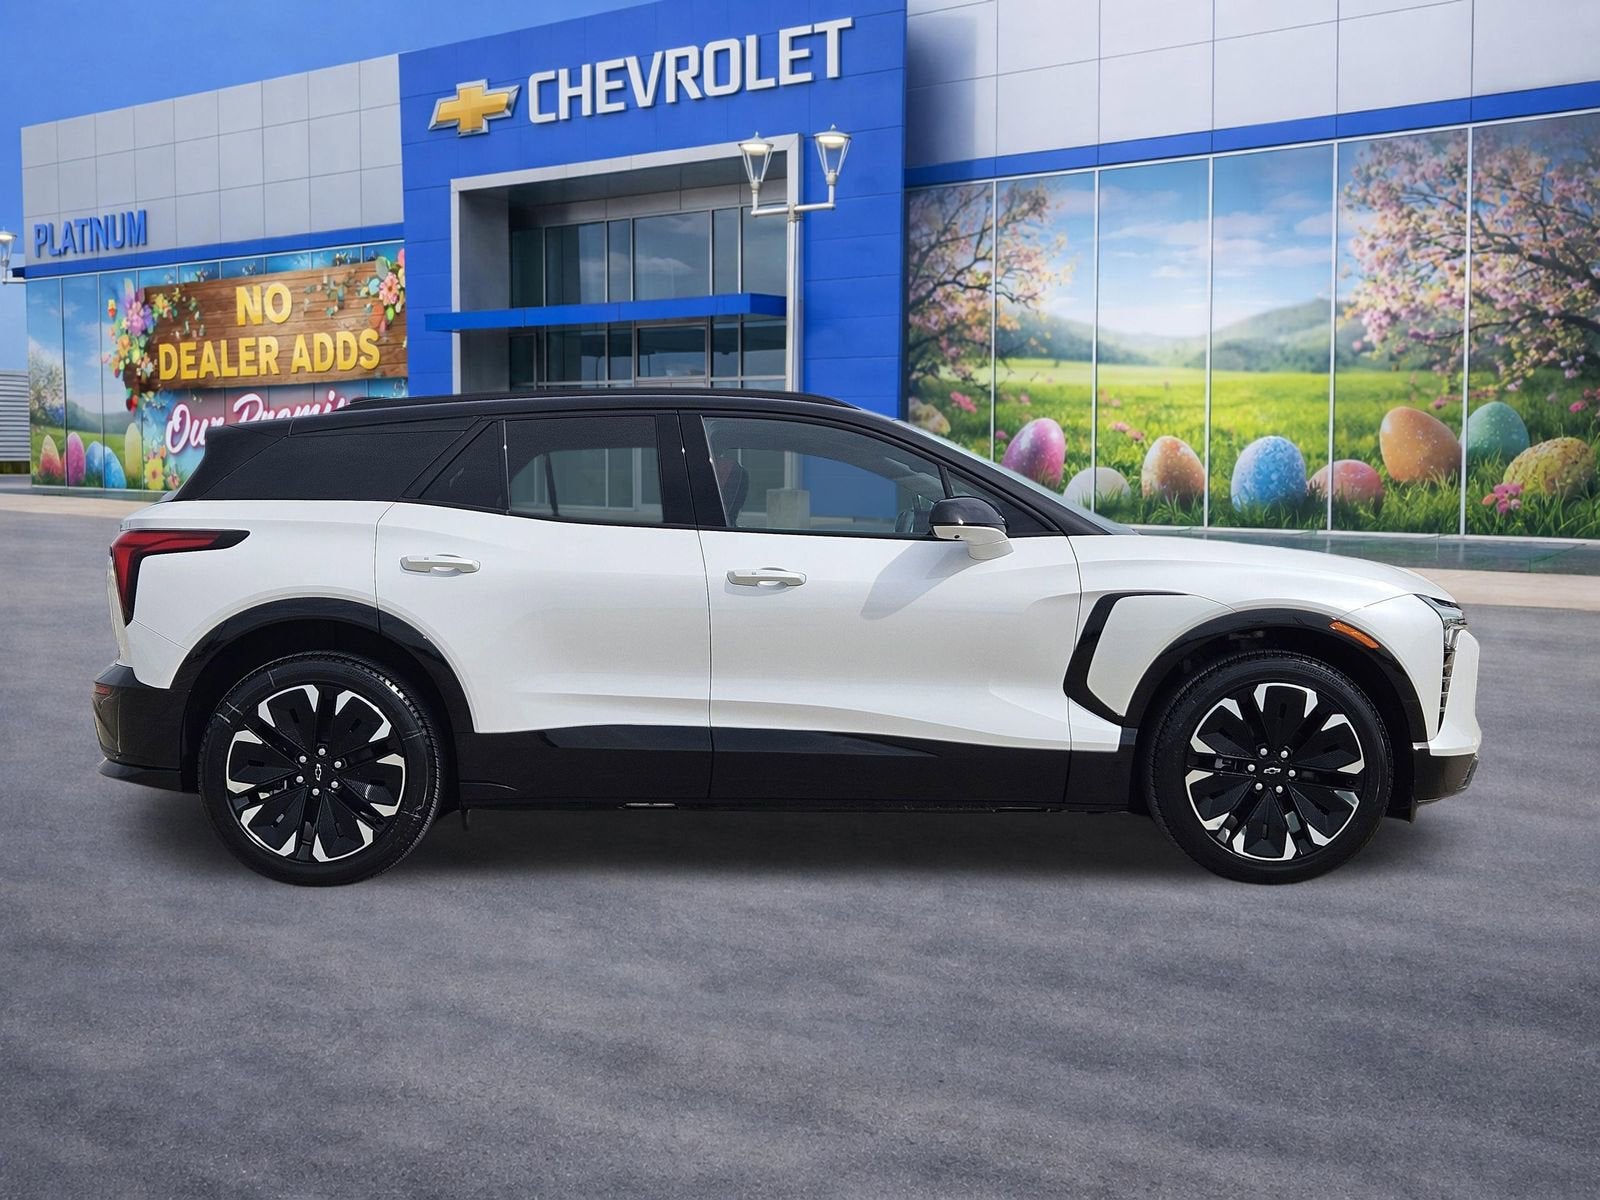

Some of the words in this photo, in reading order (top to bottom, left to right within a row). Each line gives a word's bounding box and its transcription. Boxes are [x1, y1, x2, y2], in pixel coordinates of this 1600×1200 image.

[528, 17, 853, 124] CHEVROLET
[33, 209, 148, 258] PLATINUM
[235, 282, 293, 326] NO
[157, 334, 280, 380] DEALER
[290, 329, 381, 373] ADDS
